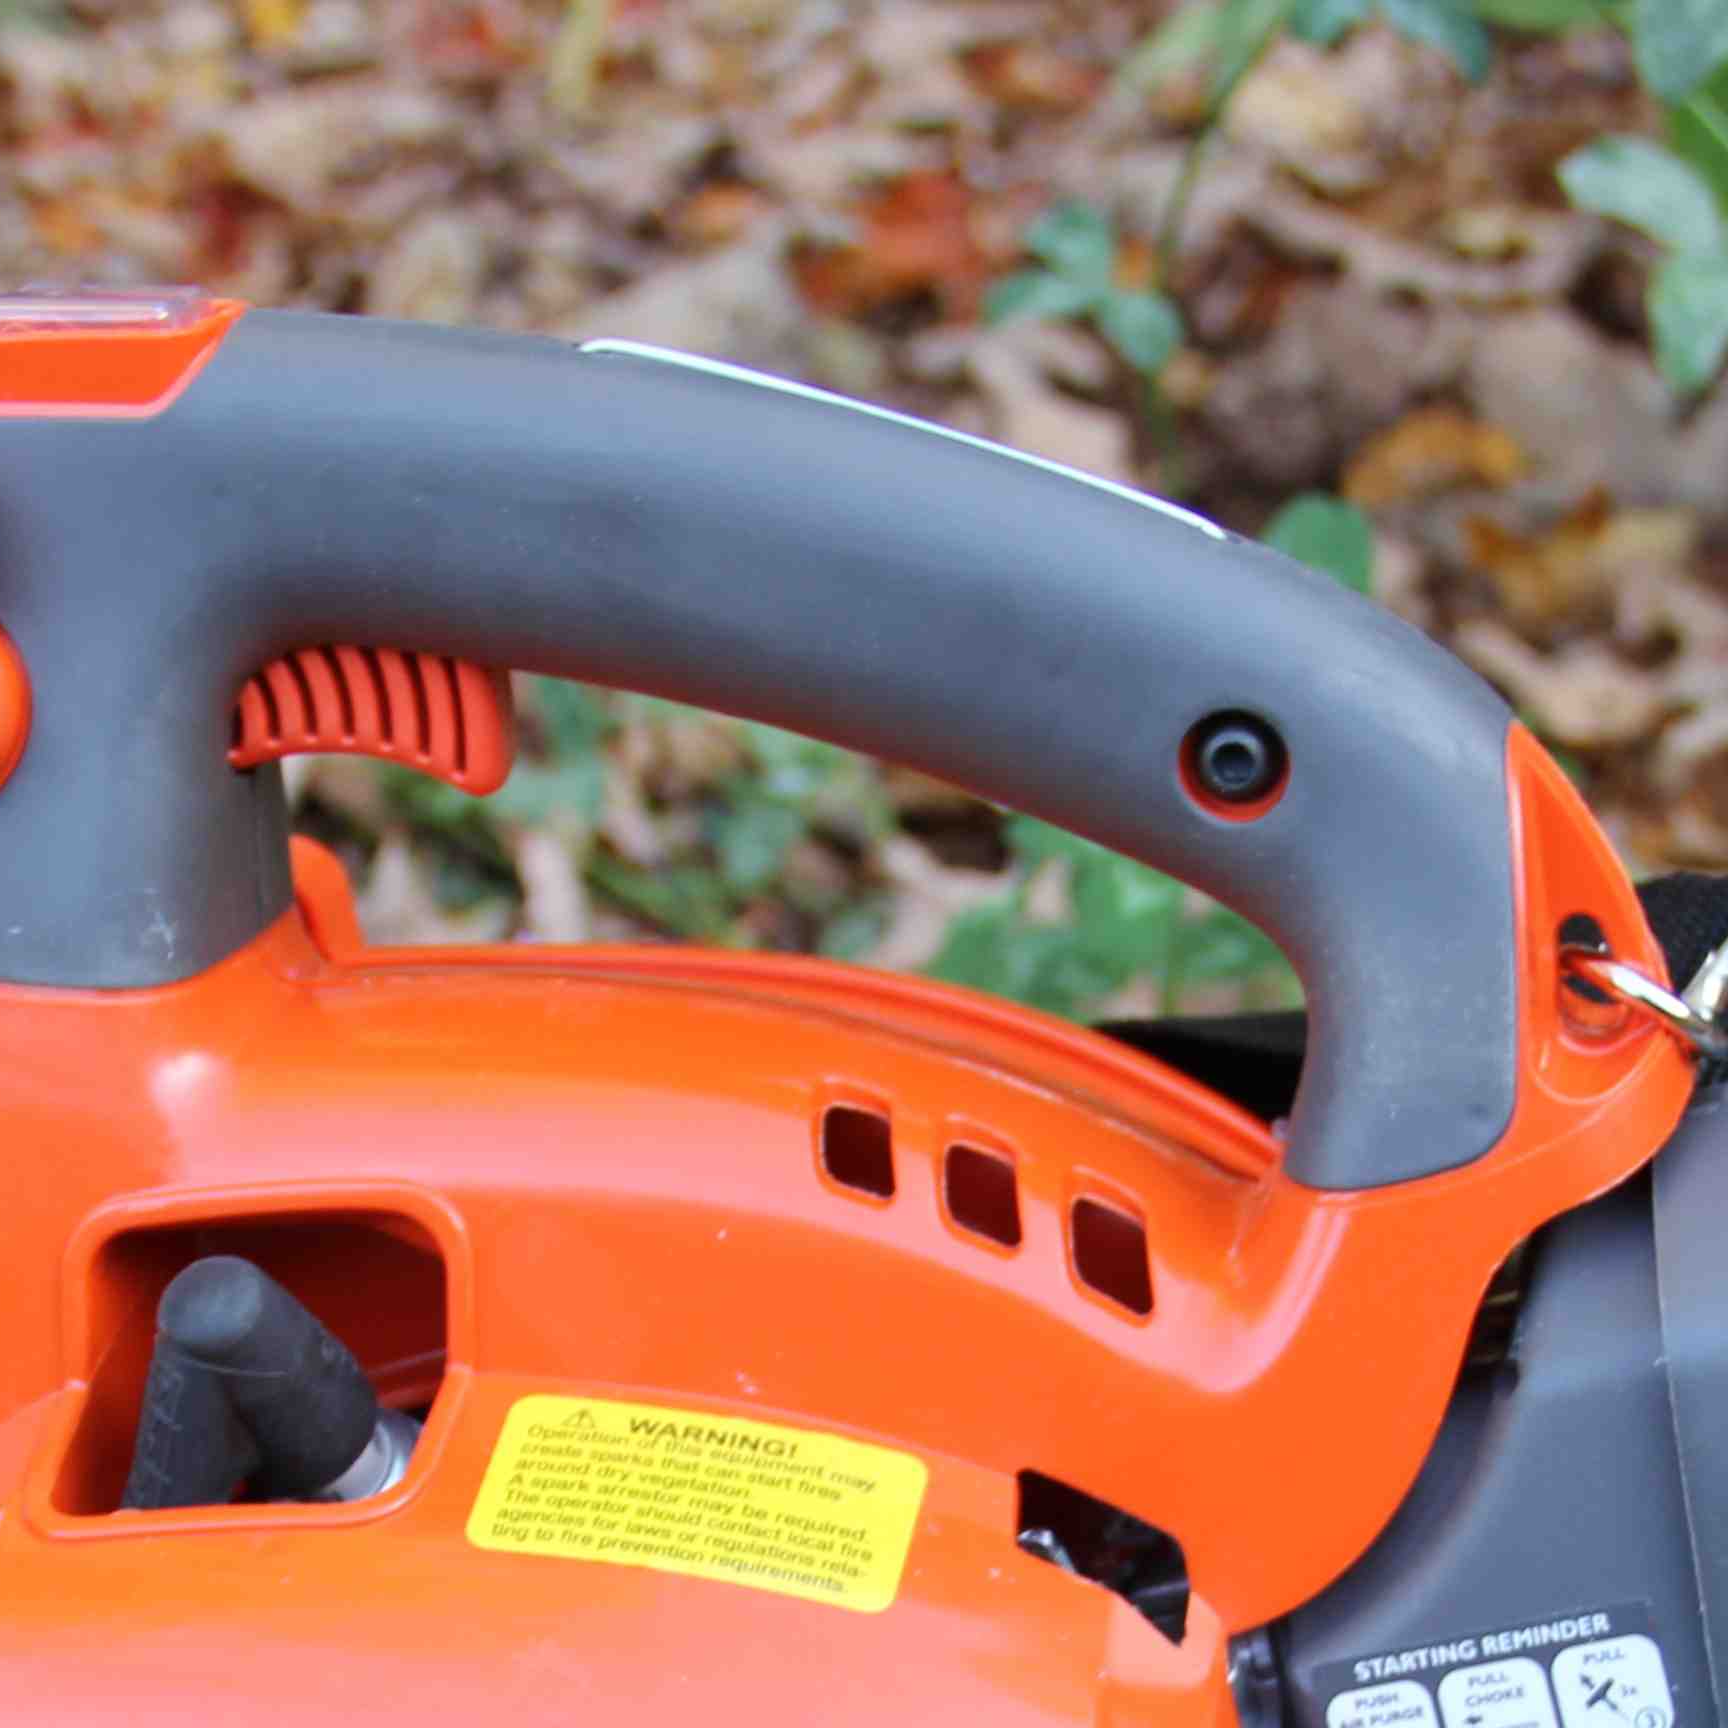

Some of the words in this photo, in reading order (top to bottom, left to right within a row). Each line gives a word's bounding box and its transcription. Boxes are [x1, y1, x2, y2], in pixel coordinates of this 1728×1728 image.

[630, 1416, 800, 1459] WARNING!
[513, 1457, 592, 1475] around
[595, 1465, 632, 1483] dry
[520, 1442, 584, 1458] create
[588, 1448, 656, 1467] sparks
[661, 1455, 700, 1472] that
[704, 1465, 742, 1480] can
[747, 1472, 793, 1492] start
[797, 1479, 843, 1501] fires
[528, 1424, 630, 1446] Operation
[636, 1435, 657, 1449] of
[709, 1447, 825, 1479] equipment
[830, 1471, 877, 1493] may
[506, 1472, 524, 1486] A
[530, 1475, 591, 1493] spark
[596, 1483, 682, 1504] arrestor
[687, 1496, 736, 1516] may
[741, 1503, 770, 1520] be
[491, 1522, 531, 1543] ting
[535, 1526, 555, 1542] to
[560, 1529, 594, 1547] fire
[596, 1536, 706, 1562] prevention
[495, 1508, 587, 1529] agencies
[591, 1514, 619, 1532] for
[624, 1521, 672, 1539] laws
[676, 1531, 699, 1545] or
[703, 1534, 816, 1567] regulations
[504, 1487, 541, 1506] The
[544, 1494, 629, 1515] operator
[634, 1505, 703, 1526] should
[706, 1516, 782, 1541] contact
[786, 1530, 836, 1552] local
[839, 1542, 874, 1562] fire
[1353, 1638, 1478, 1683] STARTING
[1481, 1611, 1611, 1656] REMINDER
[1581, 1647, 1627, 1666] PULL
[1354, 1692, 1400, 1711] PUSH
[1463, 1685, 1526, 1707] CHOKE
[1467, 1672, 1511, 1690] PULL
[1369, 1704, 1425, 1727] PURGE
